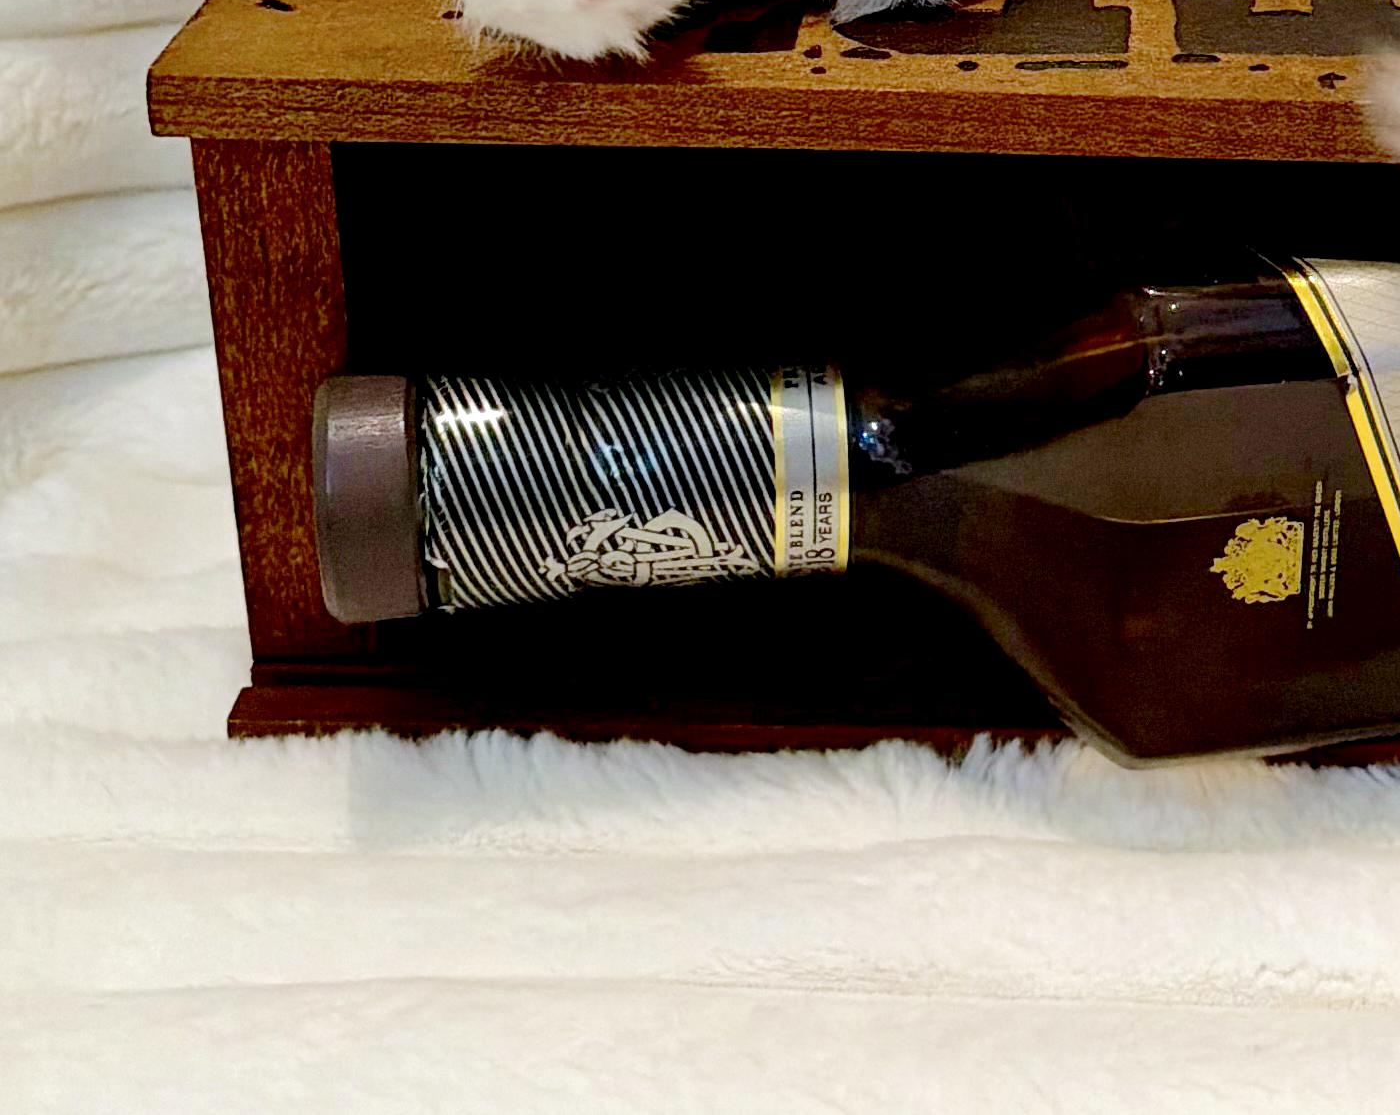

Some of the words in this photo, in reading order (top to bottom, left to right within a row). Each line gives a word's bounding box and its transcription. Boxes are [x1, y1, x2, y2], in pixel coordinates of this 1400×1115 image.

[790, 490, 804, 548] BLEND
[819, 492, 832, 543] YEARS
[805, 548, 834, 565] 18
